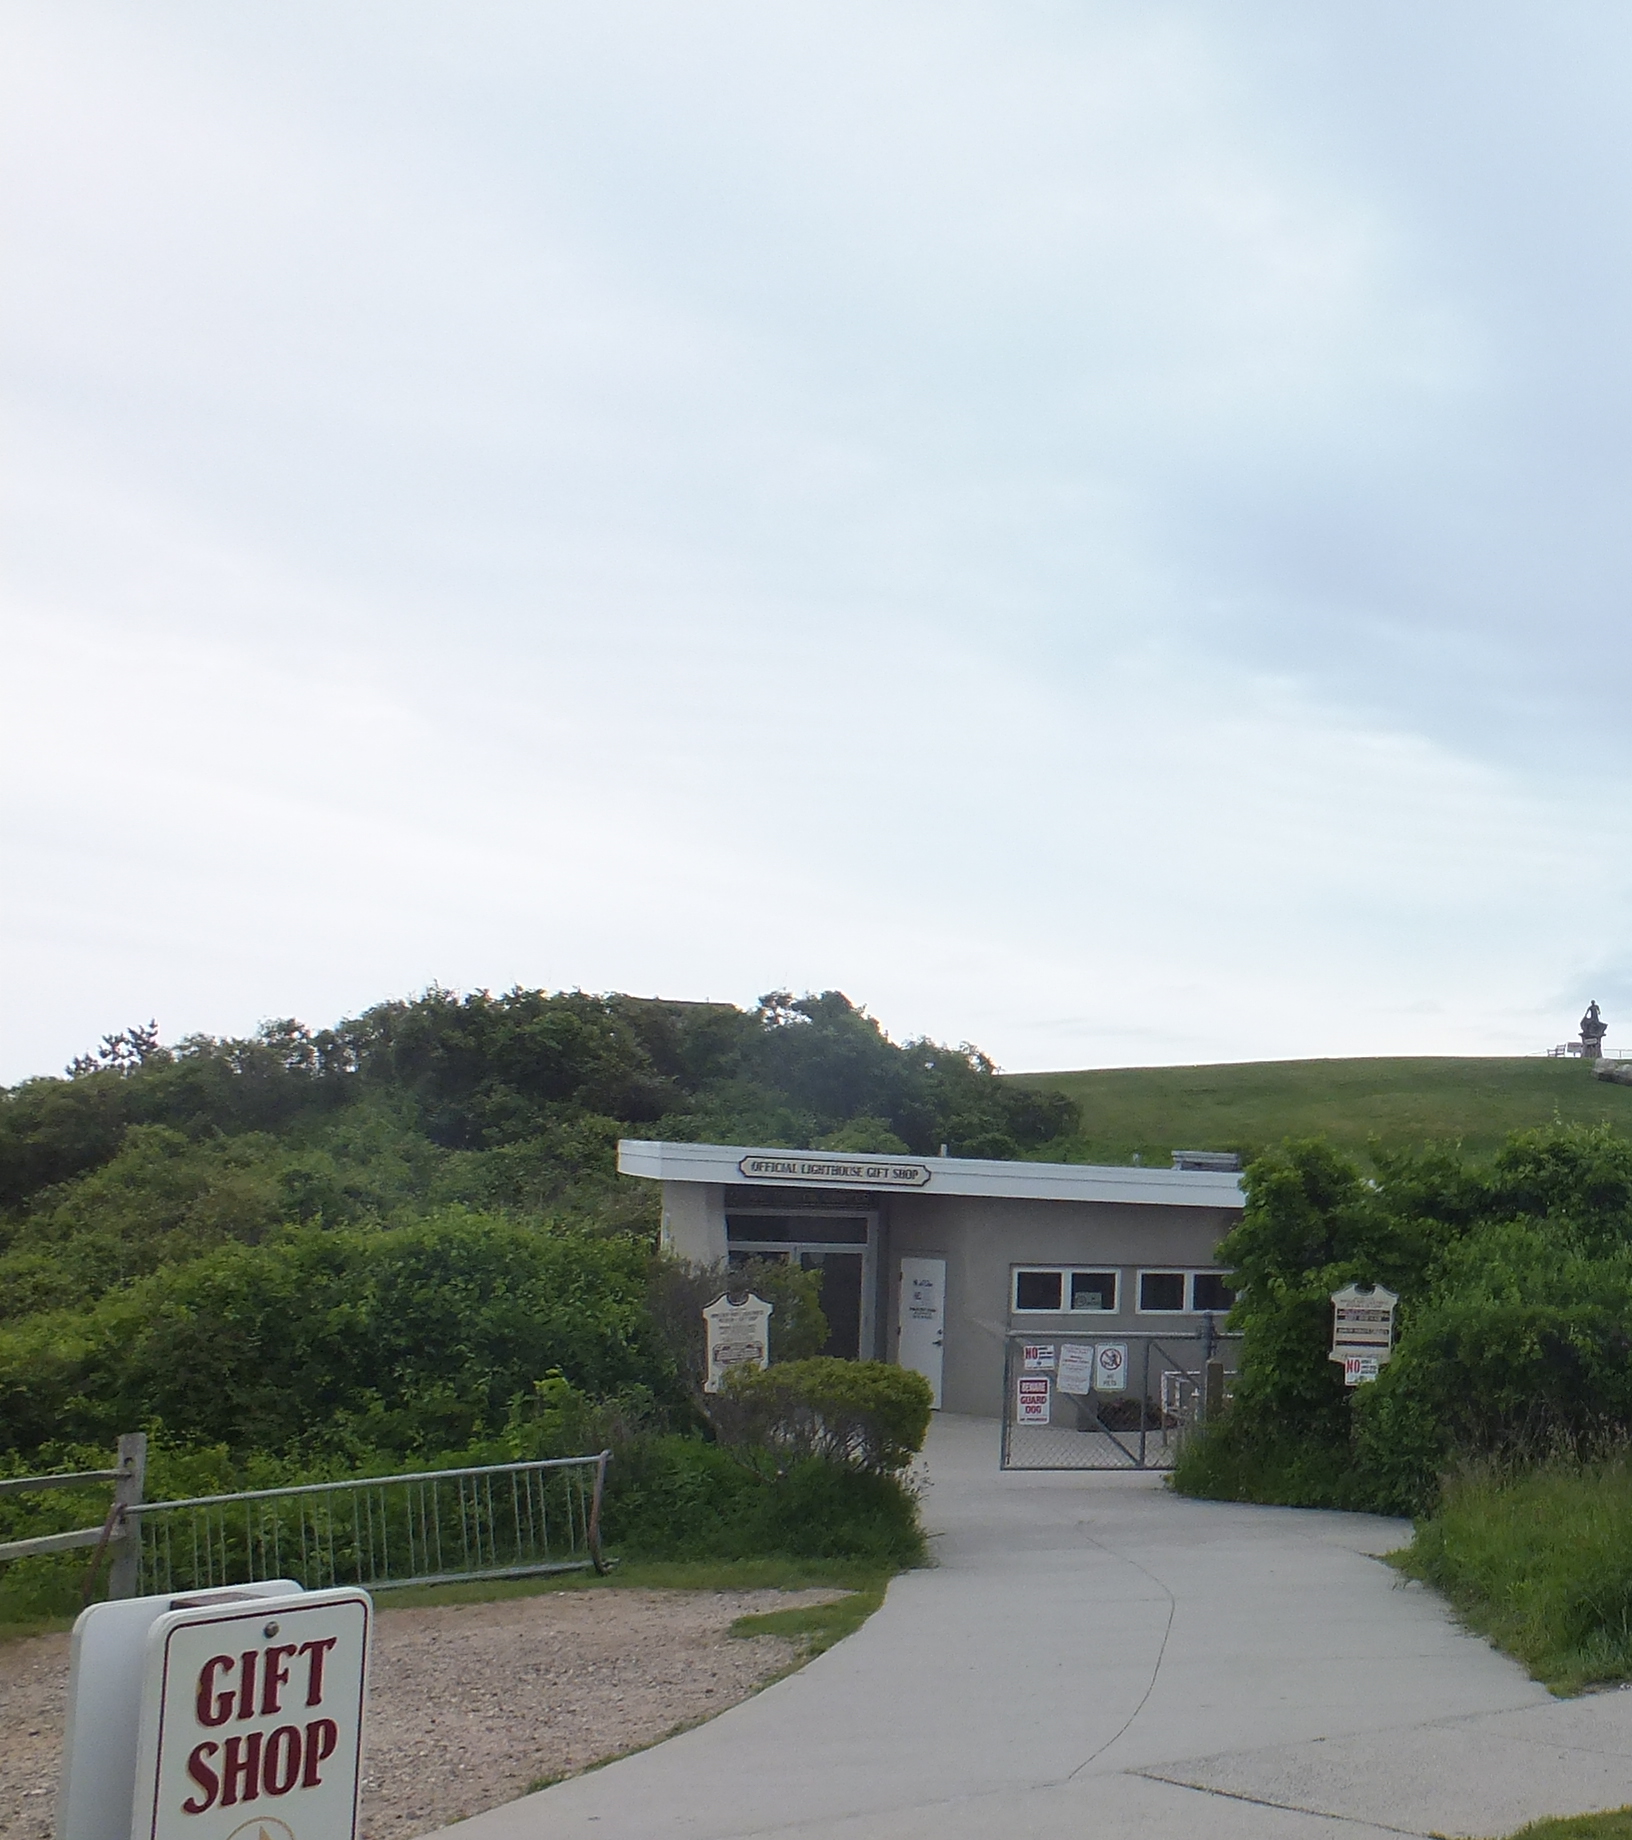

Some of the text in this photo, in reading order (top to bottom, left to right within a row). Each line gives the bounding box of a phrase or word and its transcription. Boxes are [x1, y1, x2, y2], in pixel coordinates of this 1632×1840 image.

[751, 1161, 919, 1180] OFFICIAL LIGHTHOUSE GIFT SHOP
[1347, 1359, 1361, 1374] NO
[1020, 1396, 1047, 1404] GUARD
[1025, 1405, 1041, 1414] DOG
[196, 1637, 337, 1727] GIFT
[182, 1718, 338, 1815] SHOP
